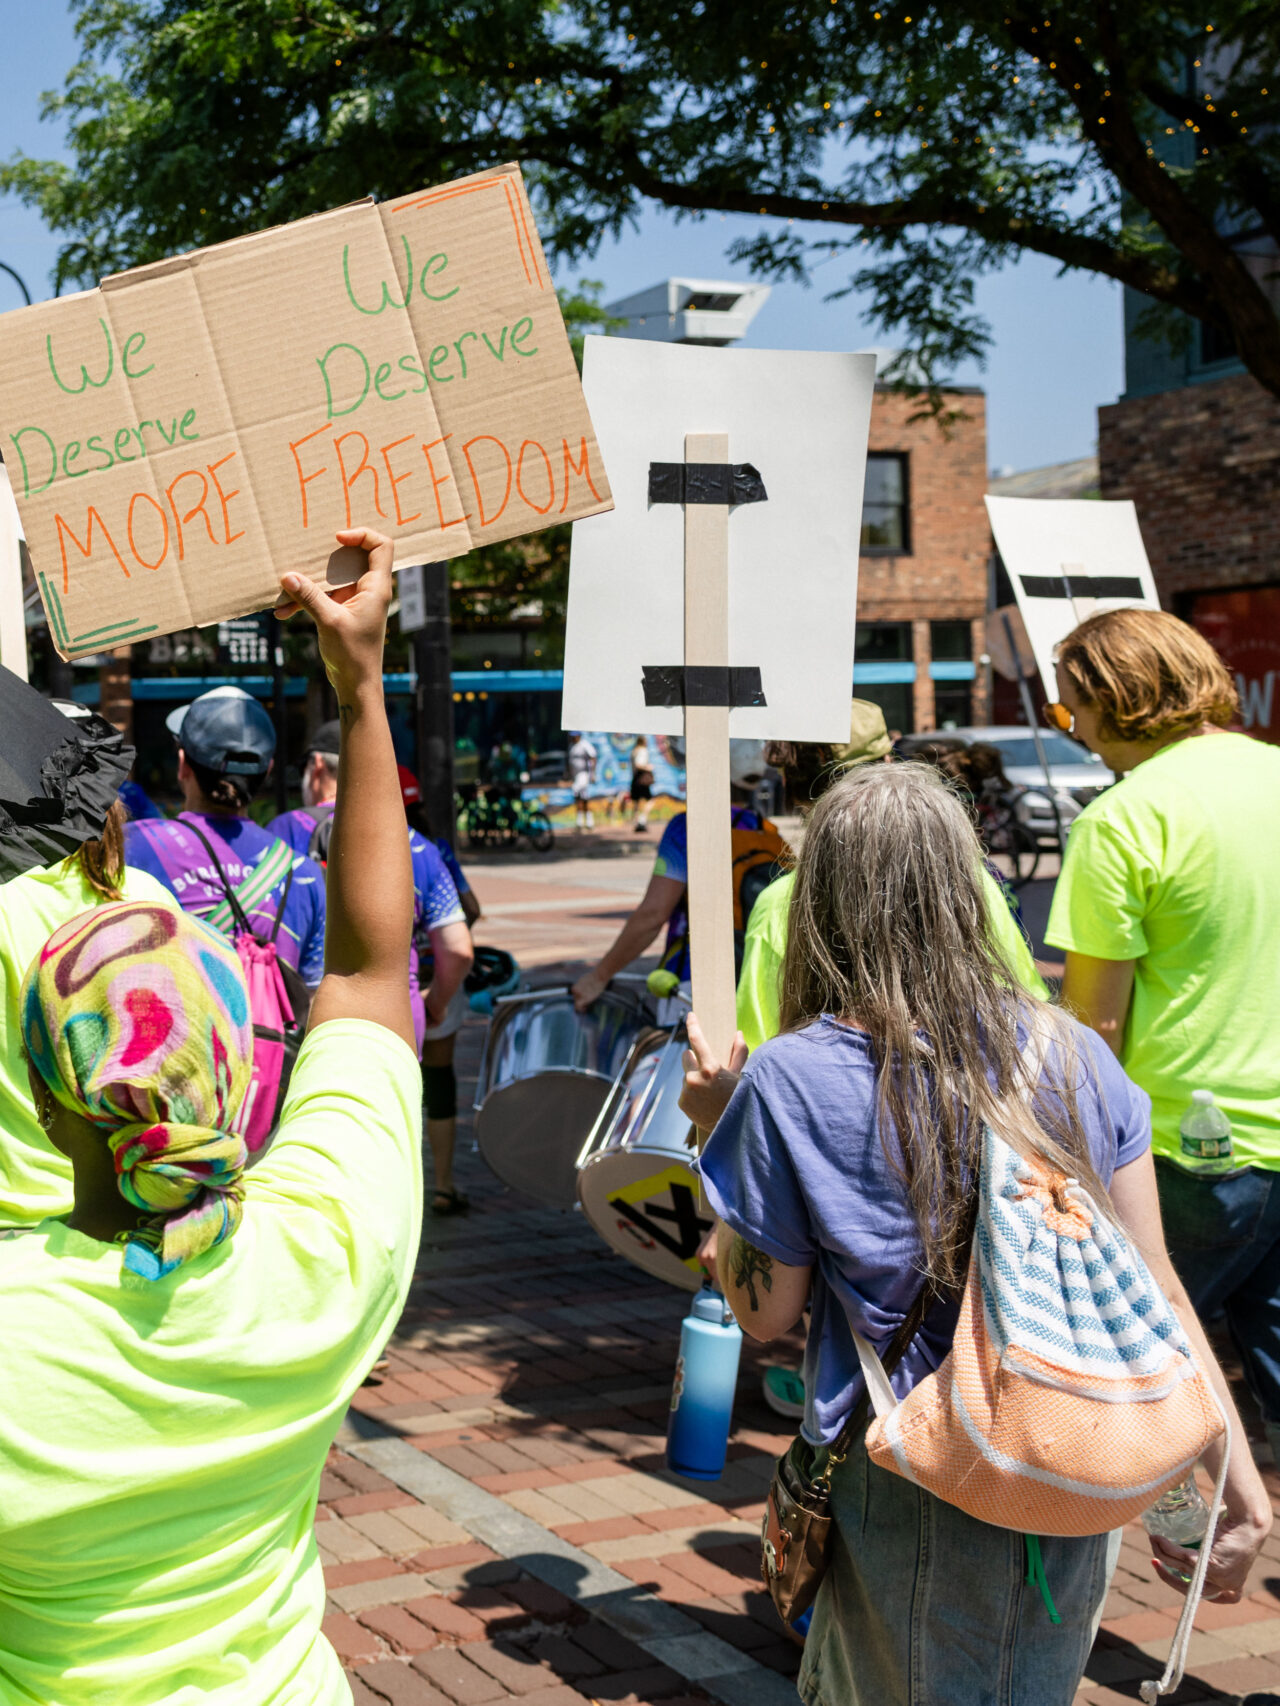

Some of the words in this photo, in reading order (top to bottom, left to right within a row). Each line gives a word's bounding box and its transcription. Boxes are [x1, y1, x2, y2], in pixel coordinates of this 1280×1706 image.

[343, 235, 460, 315] We
[46, 317, 155, 394] We
[316, 316, 538, 419] Deserve
[9, 408, 200, 499] Deserve
[289, 423, 603, 531] FREEDOM
[54, 452, 246, 595] MORE
